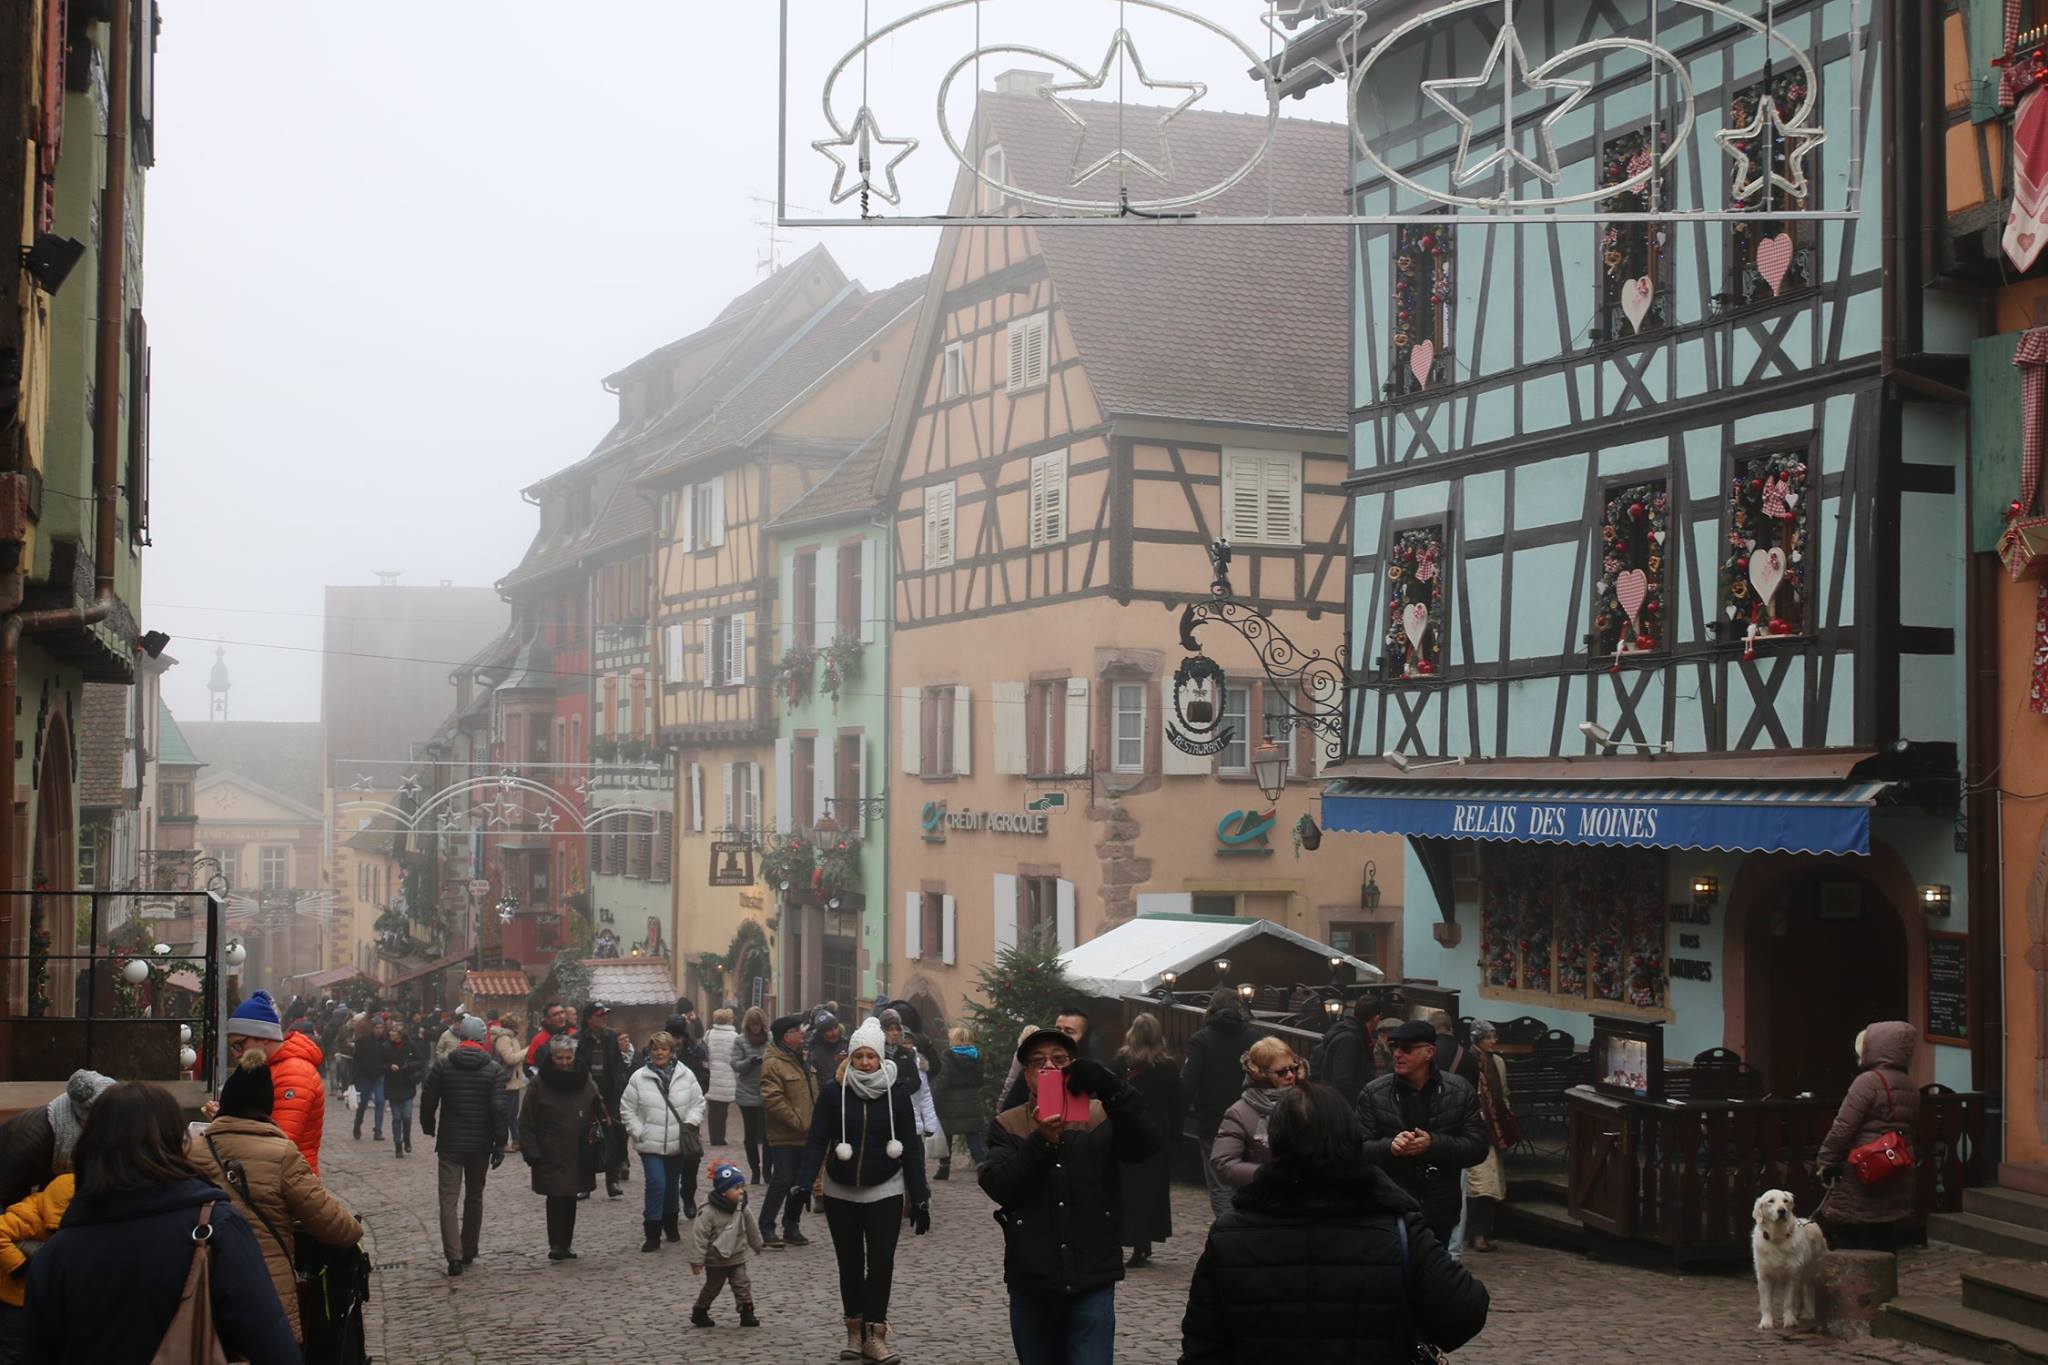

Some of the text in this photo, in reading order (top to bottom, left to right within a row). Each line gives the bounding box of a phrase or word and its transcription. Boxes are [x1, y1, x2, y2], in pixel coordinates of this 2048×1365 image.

[1173, 735, 1225, 755] RESTAURANT
[988, 811, 1047, 836] AGRICOLE
[1453, 805, 1658, 838] RELAIS DES MOINES
